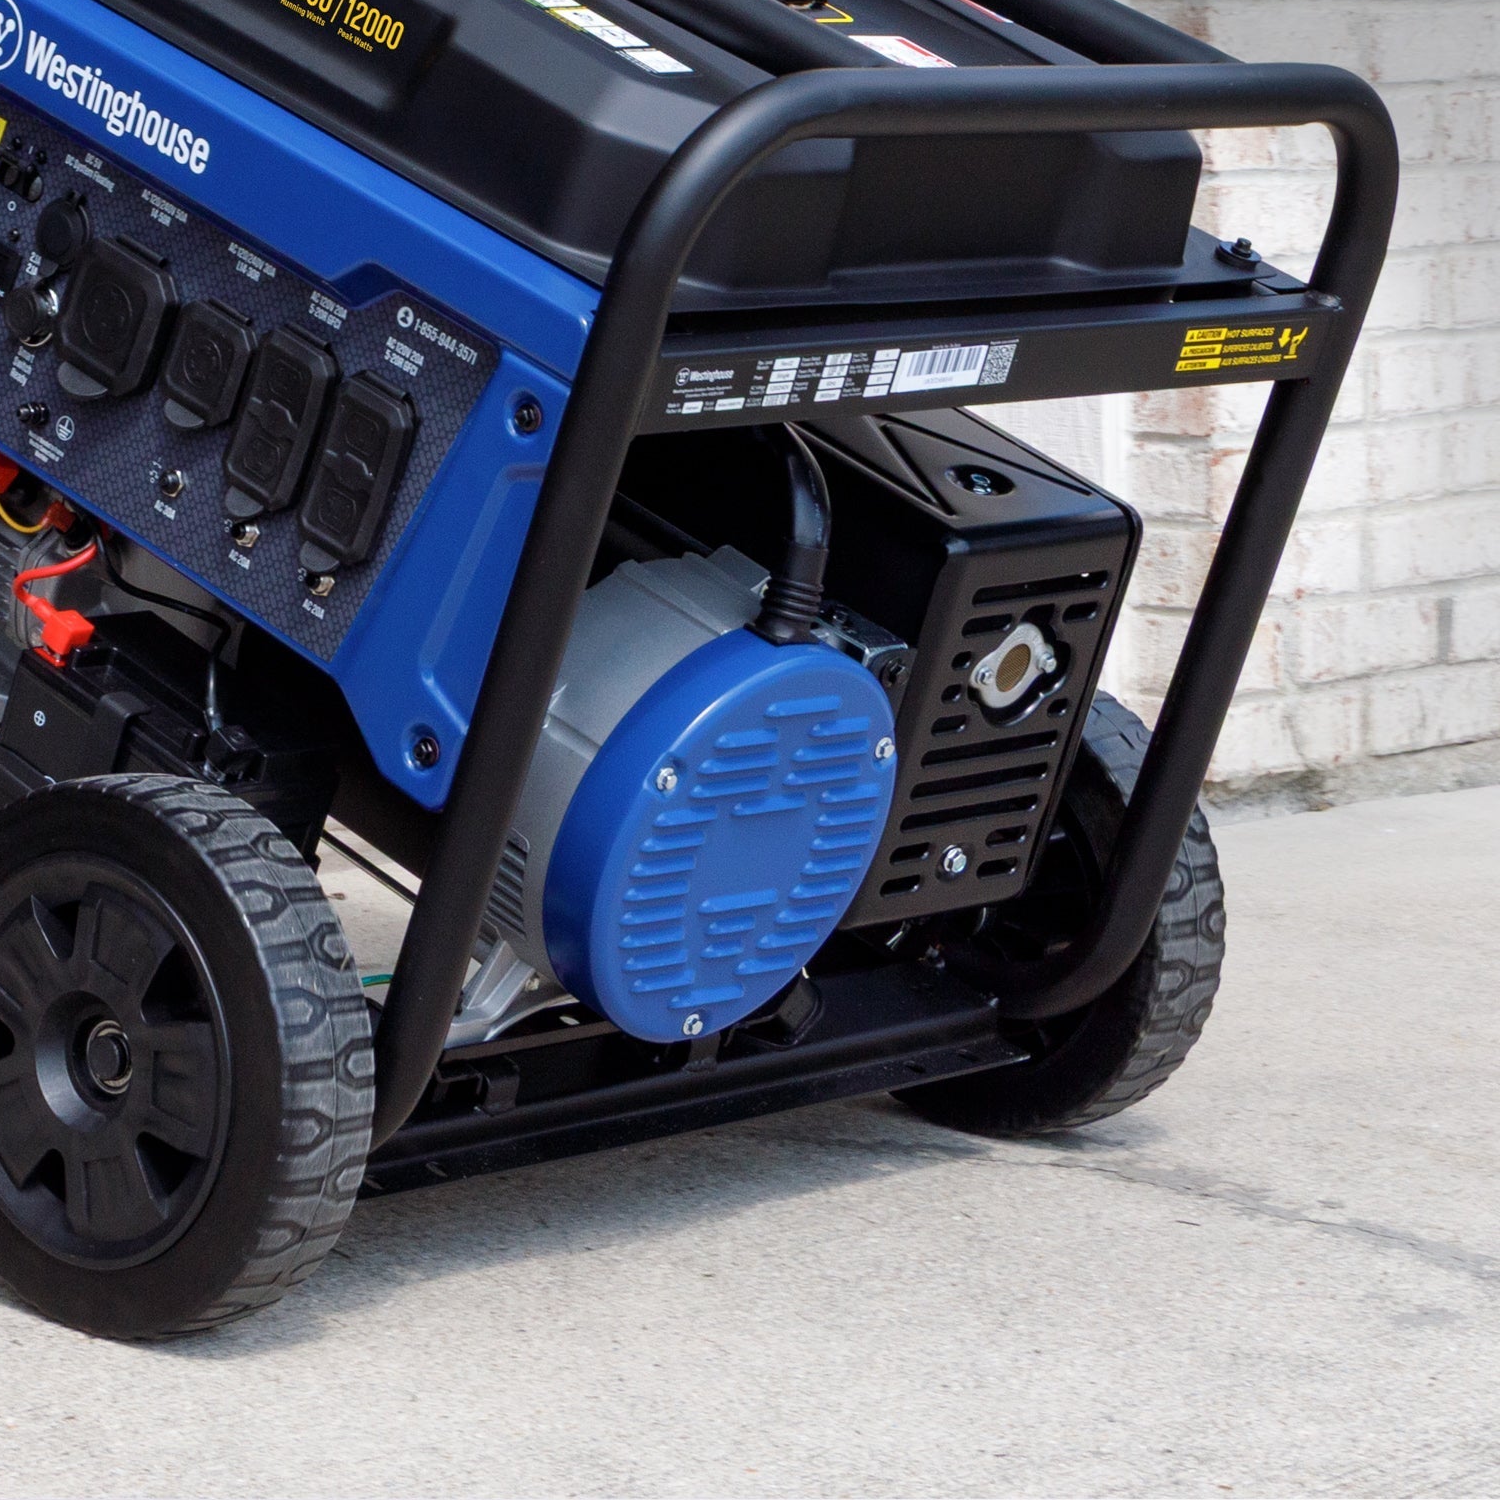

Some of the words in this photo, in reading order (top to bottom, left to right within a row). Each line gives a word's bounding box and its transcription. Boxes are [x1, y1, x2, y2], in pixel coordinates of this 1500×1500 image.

[306, 10, 326, 26] Watts
[337, 28, 353, 41] Peak
[354, 37, 374, 52] Watts
[26, 31, 209, 173] Westinghouse
[414, 318, 478, 365] 1-855-944-3571
[1227, 330, 1240, 338] HOT
[1240, 328, 1275, 338] SURFACES
[385, 336, 396, 349] AC
[395, 341, 411, 358] 120V
[410, 350, 425, 367] 20A
[690, 369, 734, 382] Westinghouse
